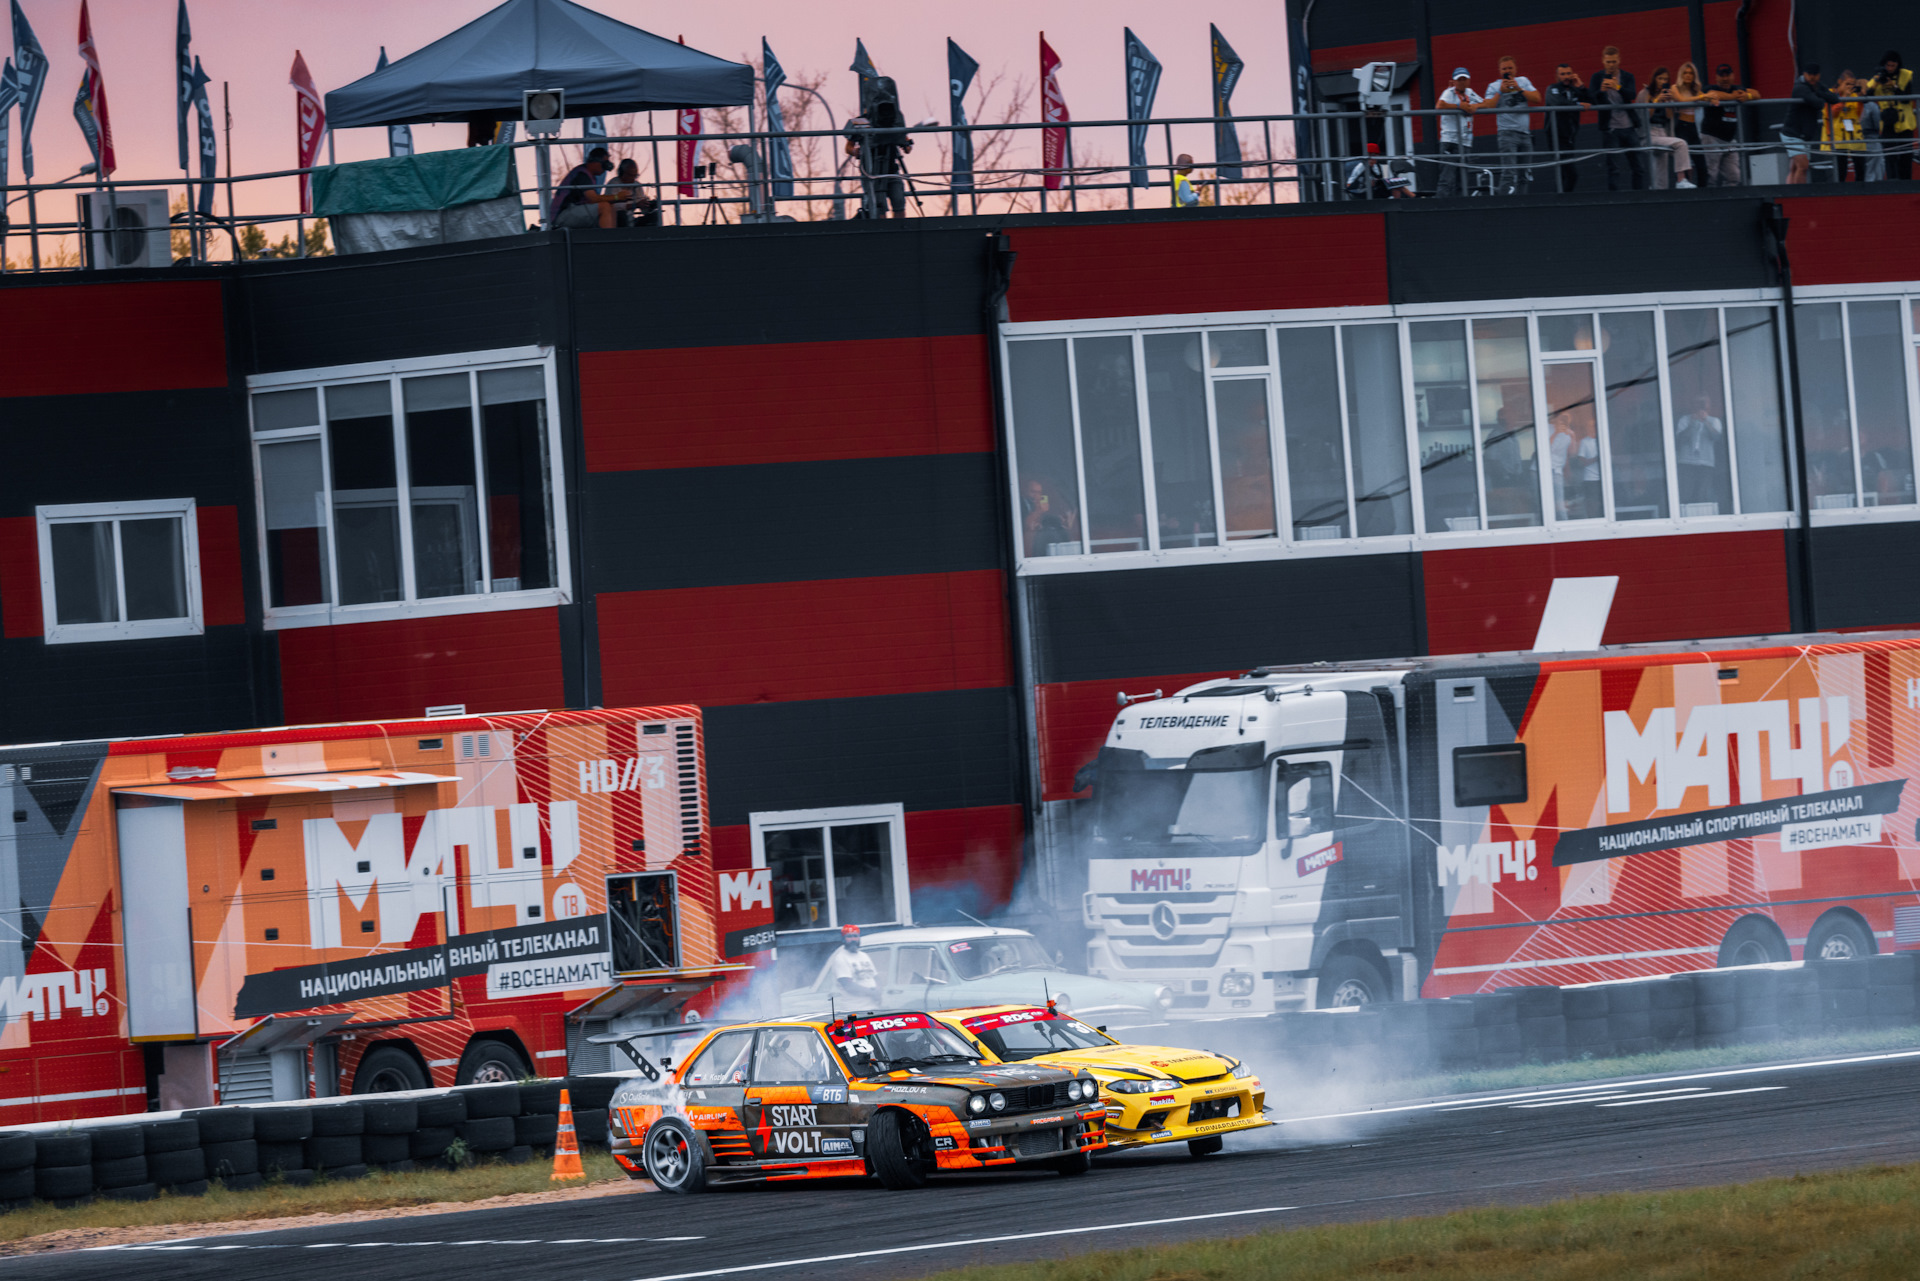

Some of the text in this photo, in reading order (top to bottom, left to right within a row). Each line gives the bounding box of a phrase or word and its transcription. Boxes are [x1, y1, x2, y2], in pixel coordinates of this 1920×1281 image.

[1140, 715, 1229, 729] ТЕЛЕВИДЕНИЕ
[1599, 795, 1864, 852] НАЦИОНАЛЬНЫЙ СПОРТИВНЫЙ ТЕЛЕКАНАЛ
[1789, 822, 1871, 846] #ВСЕНАМАТЧ
[1304, 847, 1337, 872] МАТЧ!
[1437, 839, 1538, 887] МАТЧ!
[1130, 868, 1192, 891] МАТЧ!
[562, 895, 578, 916] ТВ
[300, 954, 446, 1000] НАЦИОНАЛЬНЫЙ
[501, 926, 600, 958] ТЕЛЕКАНАЛ
[500, 962, 612, 991] #ВСЕНАМАТЧ
[870, 1018, 907, 1030] RDS
[1000, 1012, 1034, 1023] RDS
[822, 1088, 842, 1102] ВТБ
[1150, 1098, 1176, 1106] makita
[698, 1112, 728, 1121] AIRLINE
[771, 1105, 817, 1127] START
[774, 1131, 821, 1154] VOLT
[823, 1141, 852, 1152] AIMOL
[935, 1137, 953, 1147] CR
